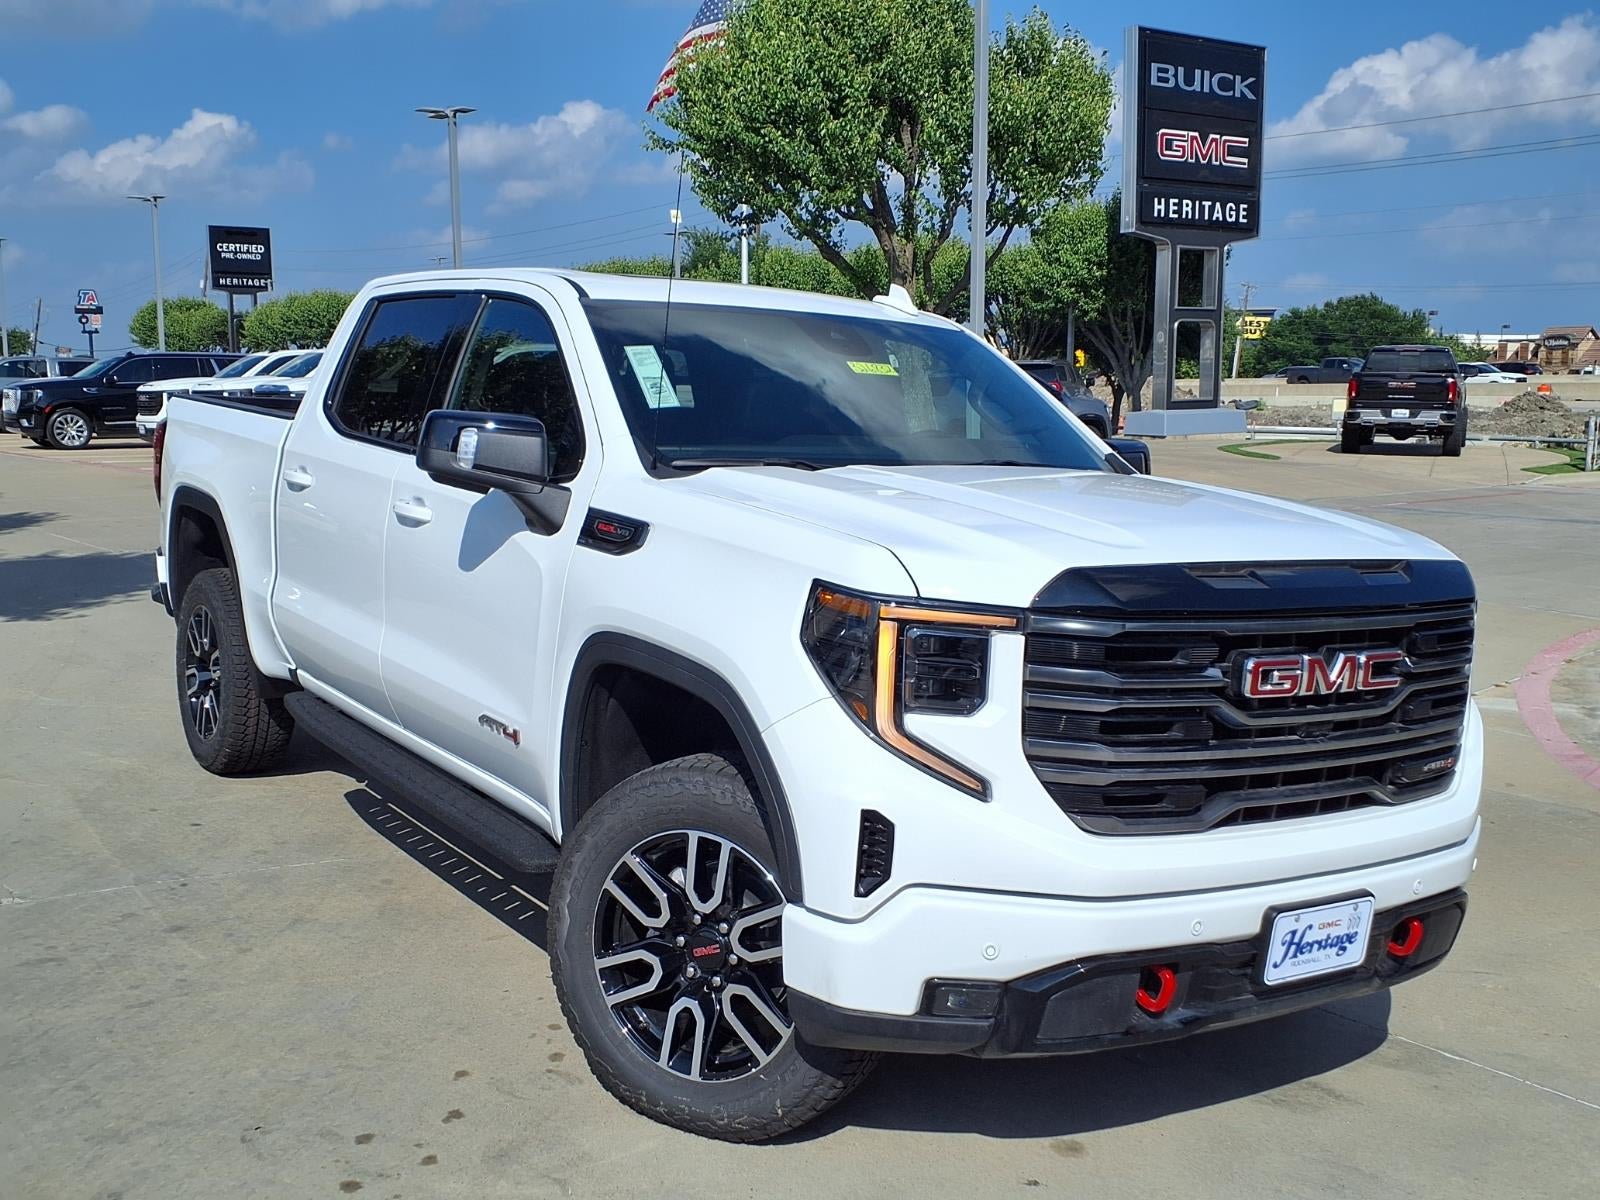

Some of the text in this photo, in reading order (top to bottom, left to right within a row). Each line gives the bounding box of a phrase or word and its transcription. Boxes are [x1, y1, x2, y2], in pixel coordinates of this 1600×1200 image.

[1151, 62, 1256, 100] BUICK
[1157, 128, 1249, 168] GMC
[1153, 197, 1248, 223] HERITAGE
[216, 243, 265, 253] CERTIFIED
[219, 278, 267, 286] HERITAGE
[79, 290, 98, 304] TA
[1243, 649, 1403, 699] GMC
[478, 713, 521, 749] AT4
[1317, 919, 1342, 930] GMC
[693, 944, 720, 956] GMC
[1272, 923, 1359, 969] Heritage
